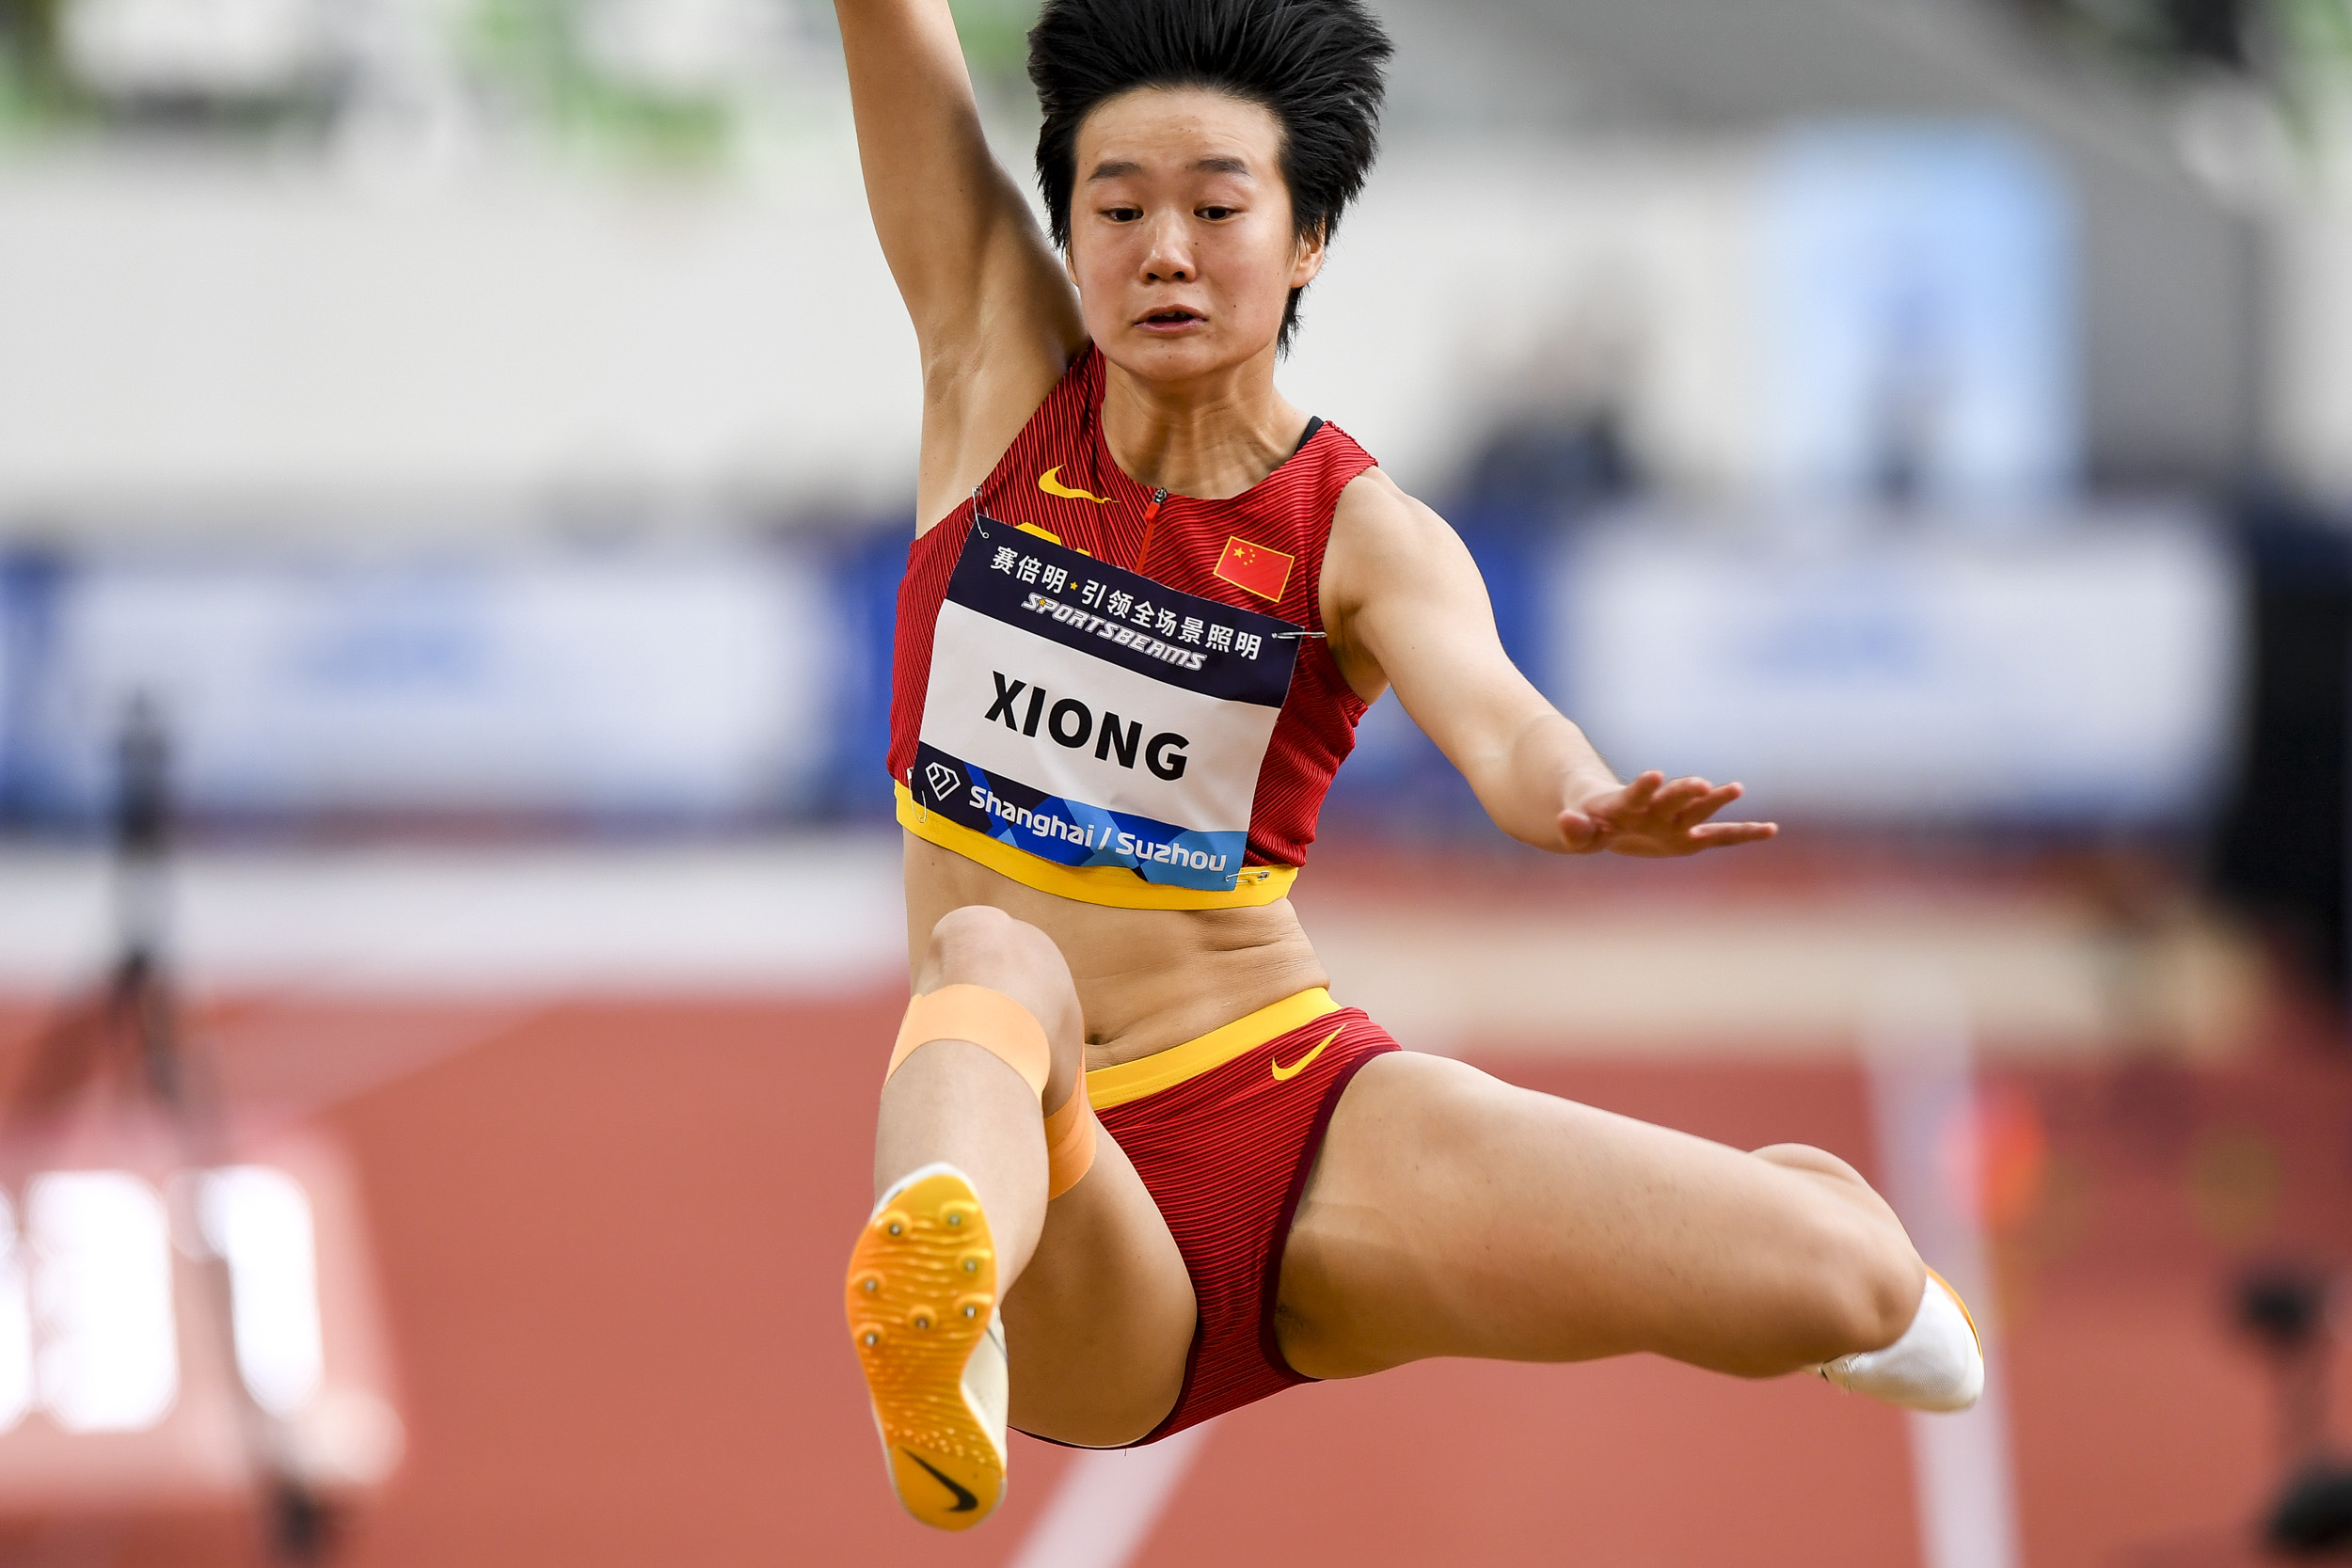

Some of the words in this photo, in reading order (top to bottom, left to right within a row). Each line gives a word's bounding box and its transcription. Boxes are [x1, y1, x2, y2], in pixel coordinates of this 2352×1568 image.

[1021, 592, 1207, 672] SPORTSBEAMS
[984, 670, 1191, 782] XIONG
[969, 785, 1095, 847] Shanghai
[1115, 832, 1227, 871] Suzhou
